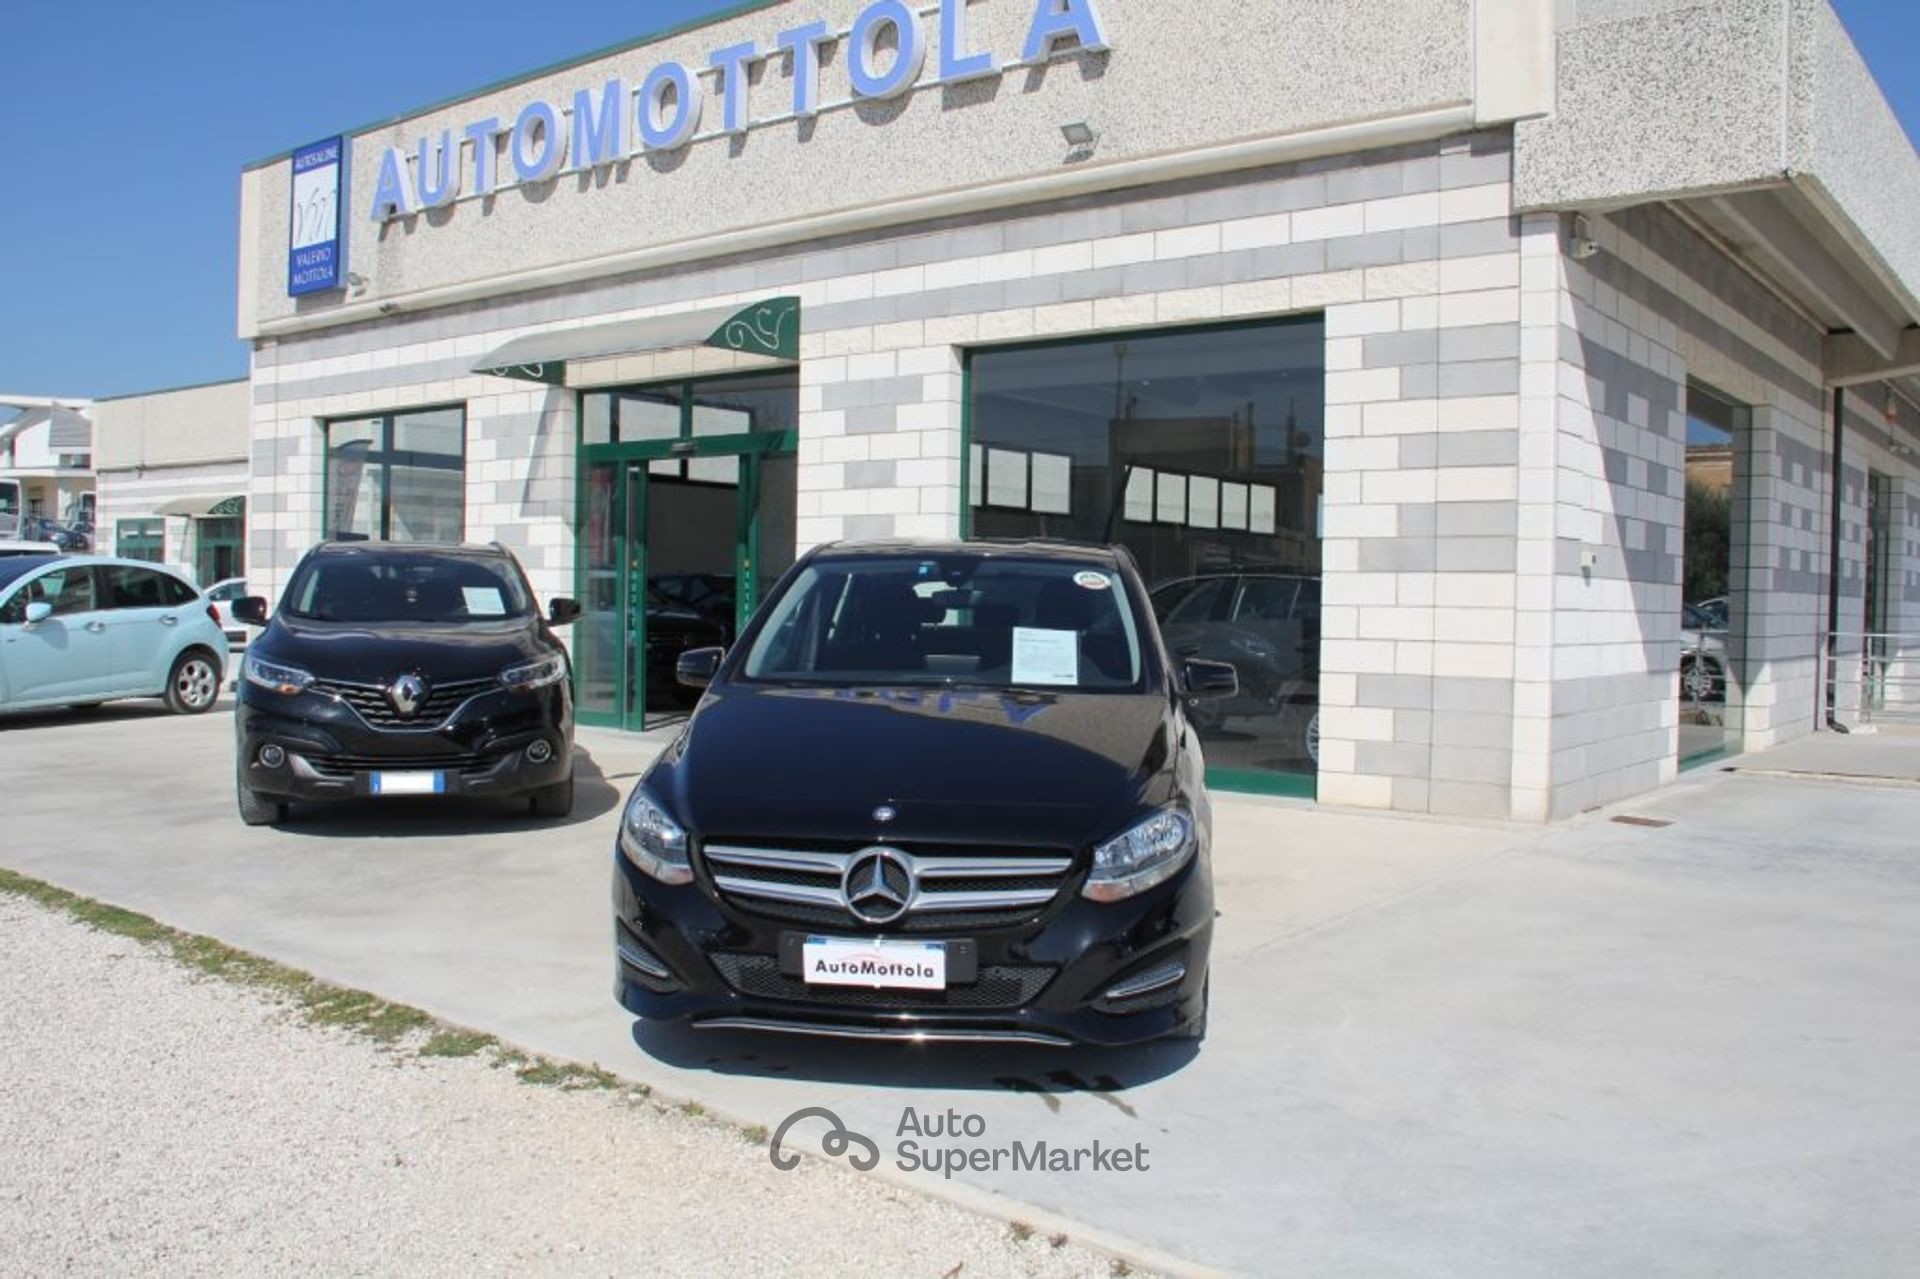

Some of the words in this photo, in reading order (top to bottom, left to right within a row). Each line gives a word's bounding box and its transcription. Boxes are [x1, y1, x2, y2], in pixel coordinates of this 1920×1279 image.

[371, 0, 1106, 222] AUTOMOTTOLA
[296, 247, 332, 268] VALERIO
[292, 265, 334, 286] MOTTOLA
[815, 959, 935, 978] AutoMottola
